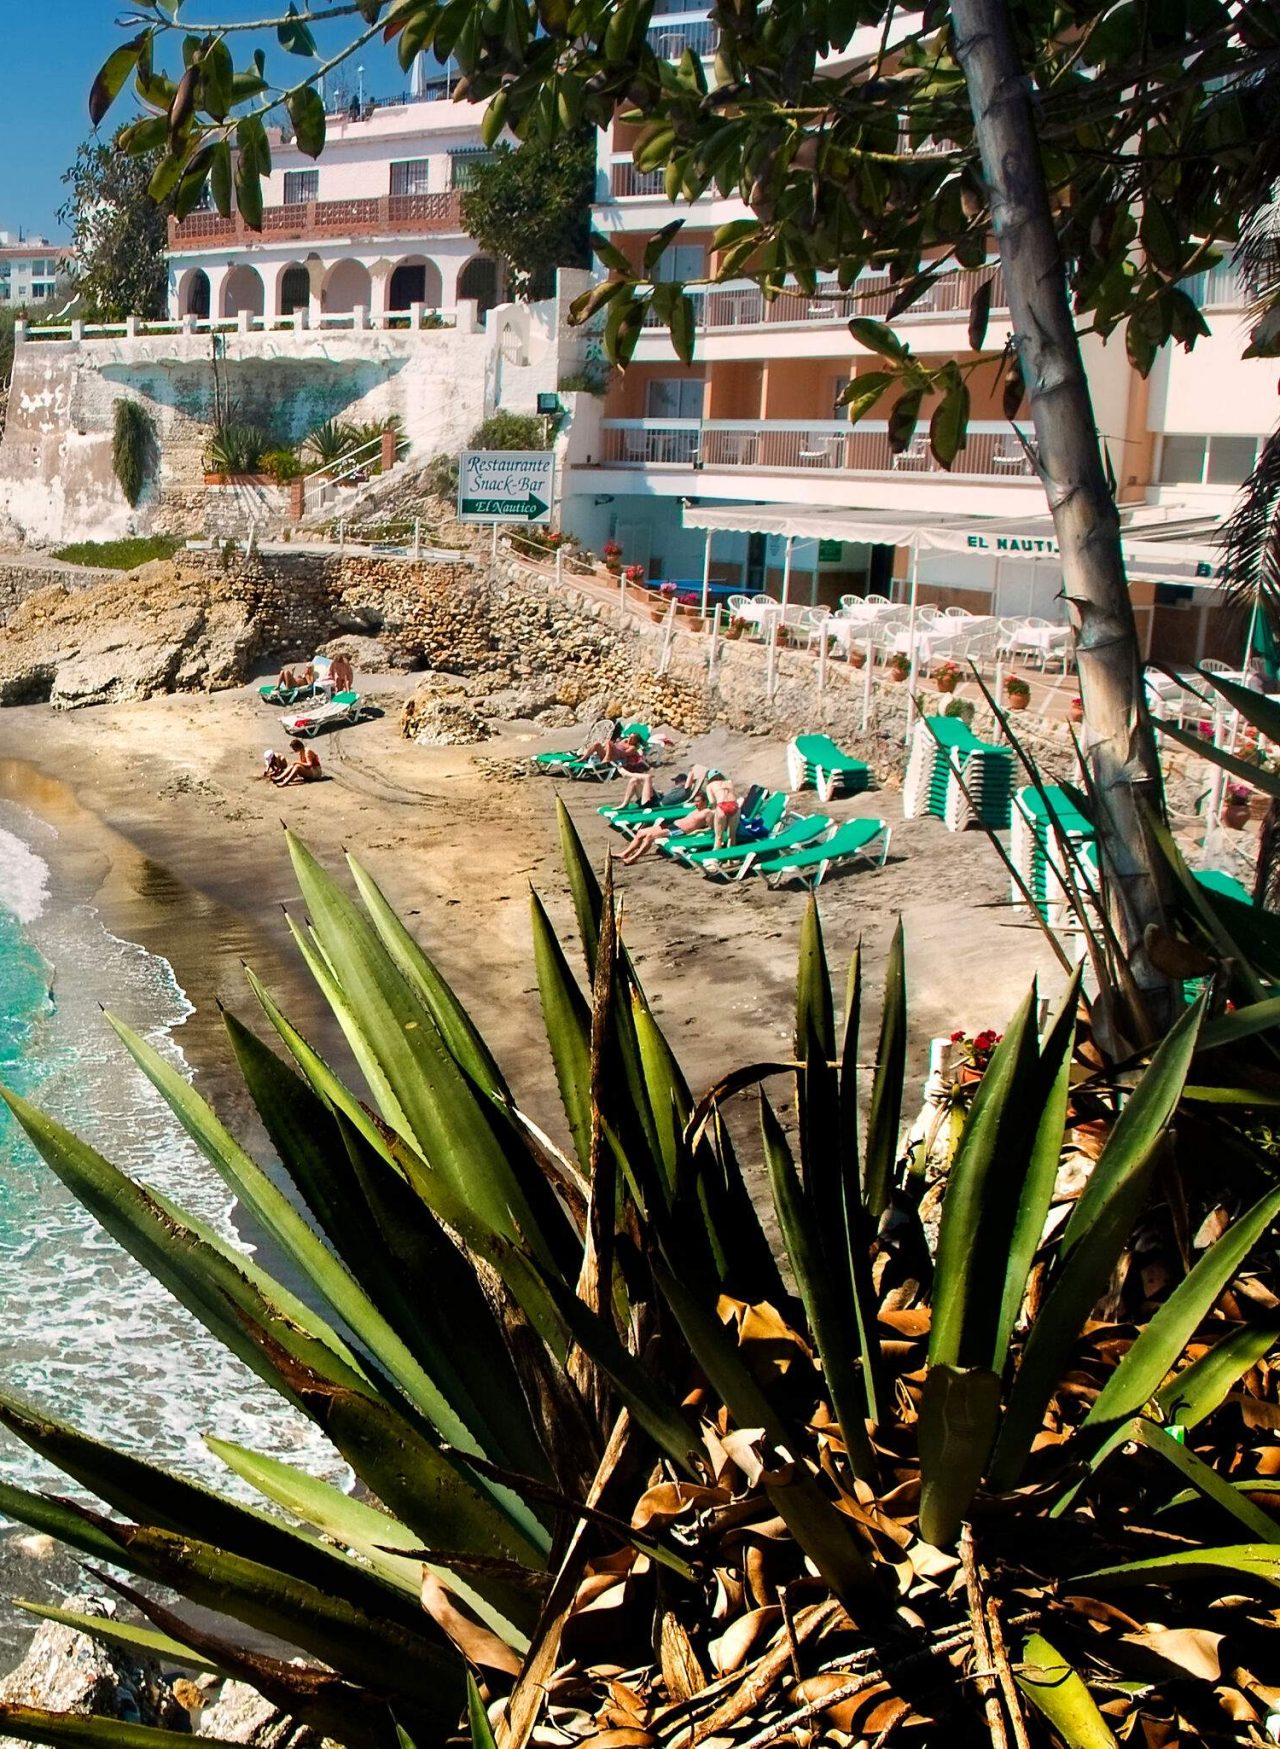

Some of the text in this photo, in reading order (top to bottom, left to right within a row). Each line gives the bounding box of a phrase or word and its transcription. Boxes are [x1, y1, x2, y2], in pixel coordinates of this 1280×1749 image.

[467, 456, 550, 474] Restaurante
[470, 474, 545, 495] Snack-Bar
[476, 501, 537, 514] El Nautico
[967, 536, 1060, 553] EL NAUTI
